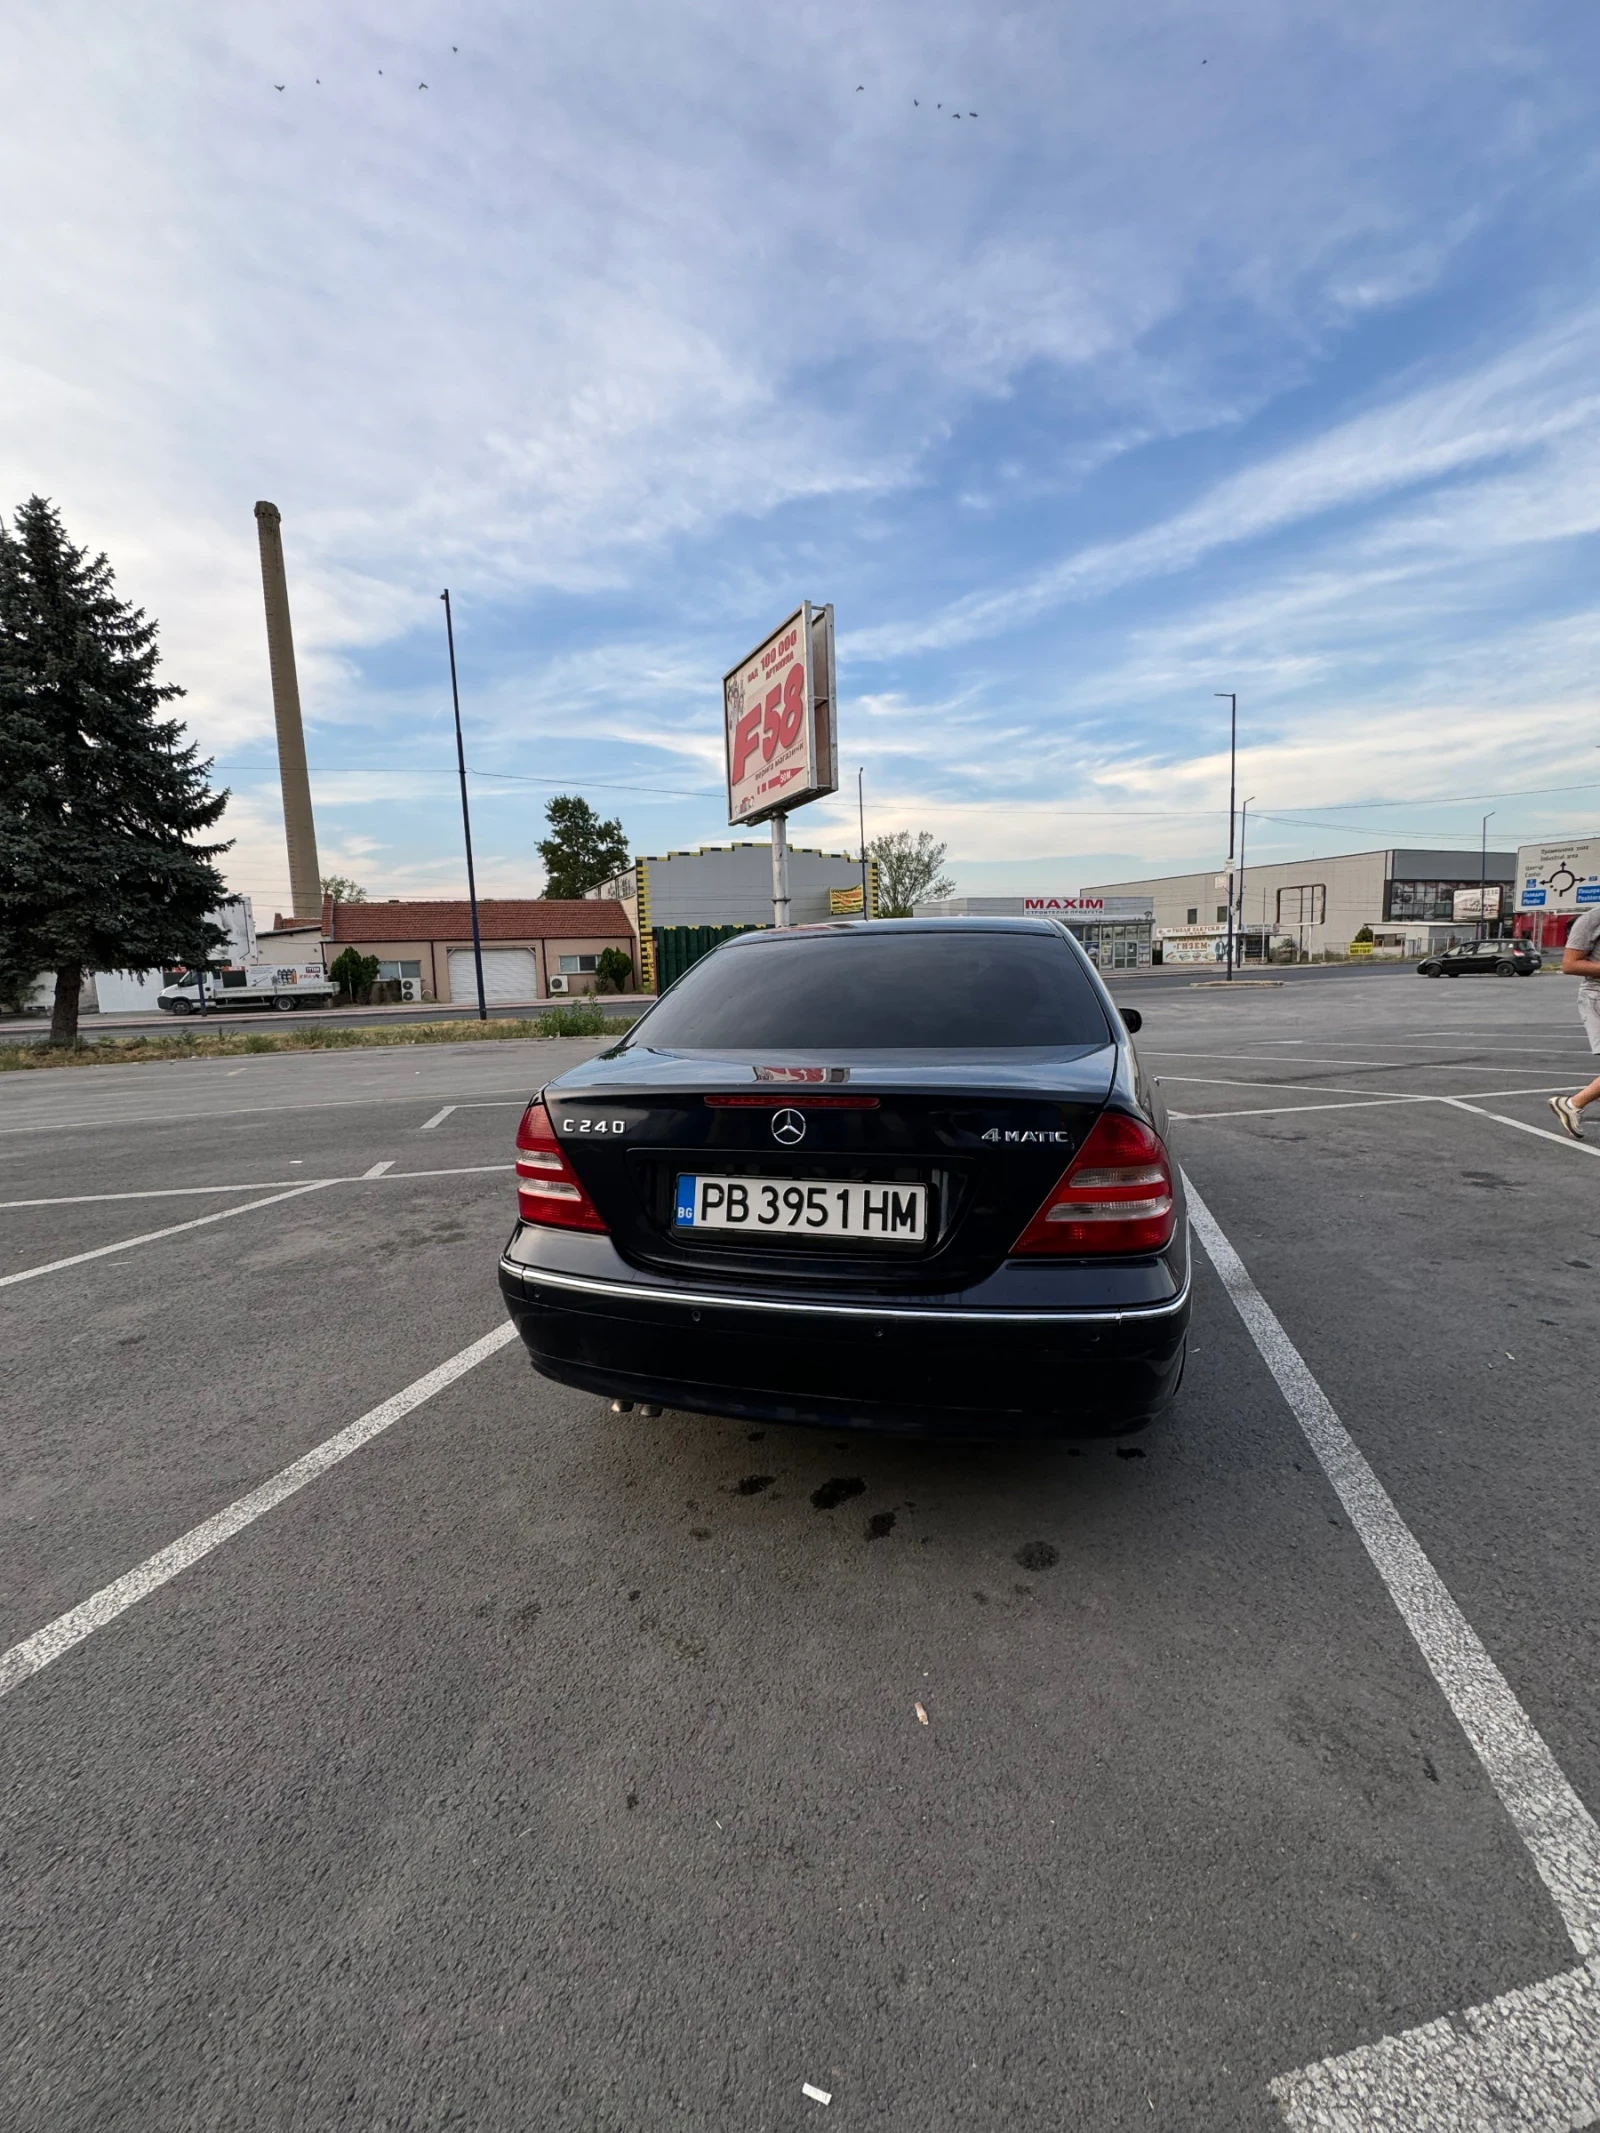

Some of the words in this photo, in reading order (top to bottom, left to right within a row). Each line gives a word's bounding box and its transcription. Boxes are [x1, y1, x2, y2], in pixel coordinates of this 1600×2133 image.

[760, 647, 776, 671] 100
[778, 629, 797, 657] 000
[732, 662, 805, 787] F58
[774, 742, 804, 768] магазини
[1025, 899, 1103, 909] MAXIM
[677, 1207, 693, 1219] BG
